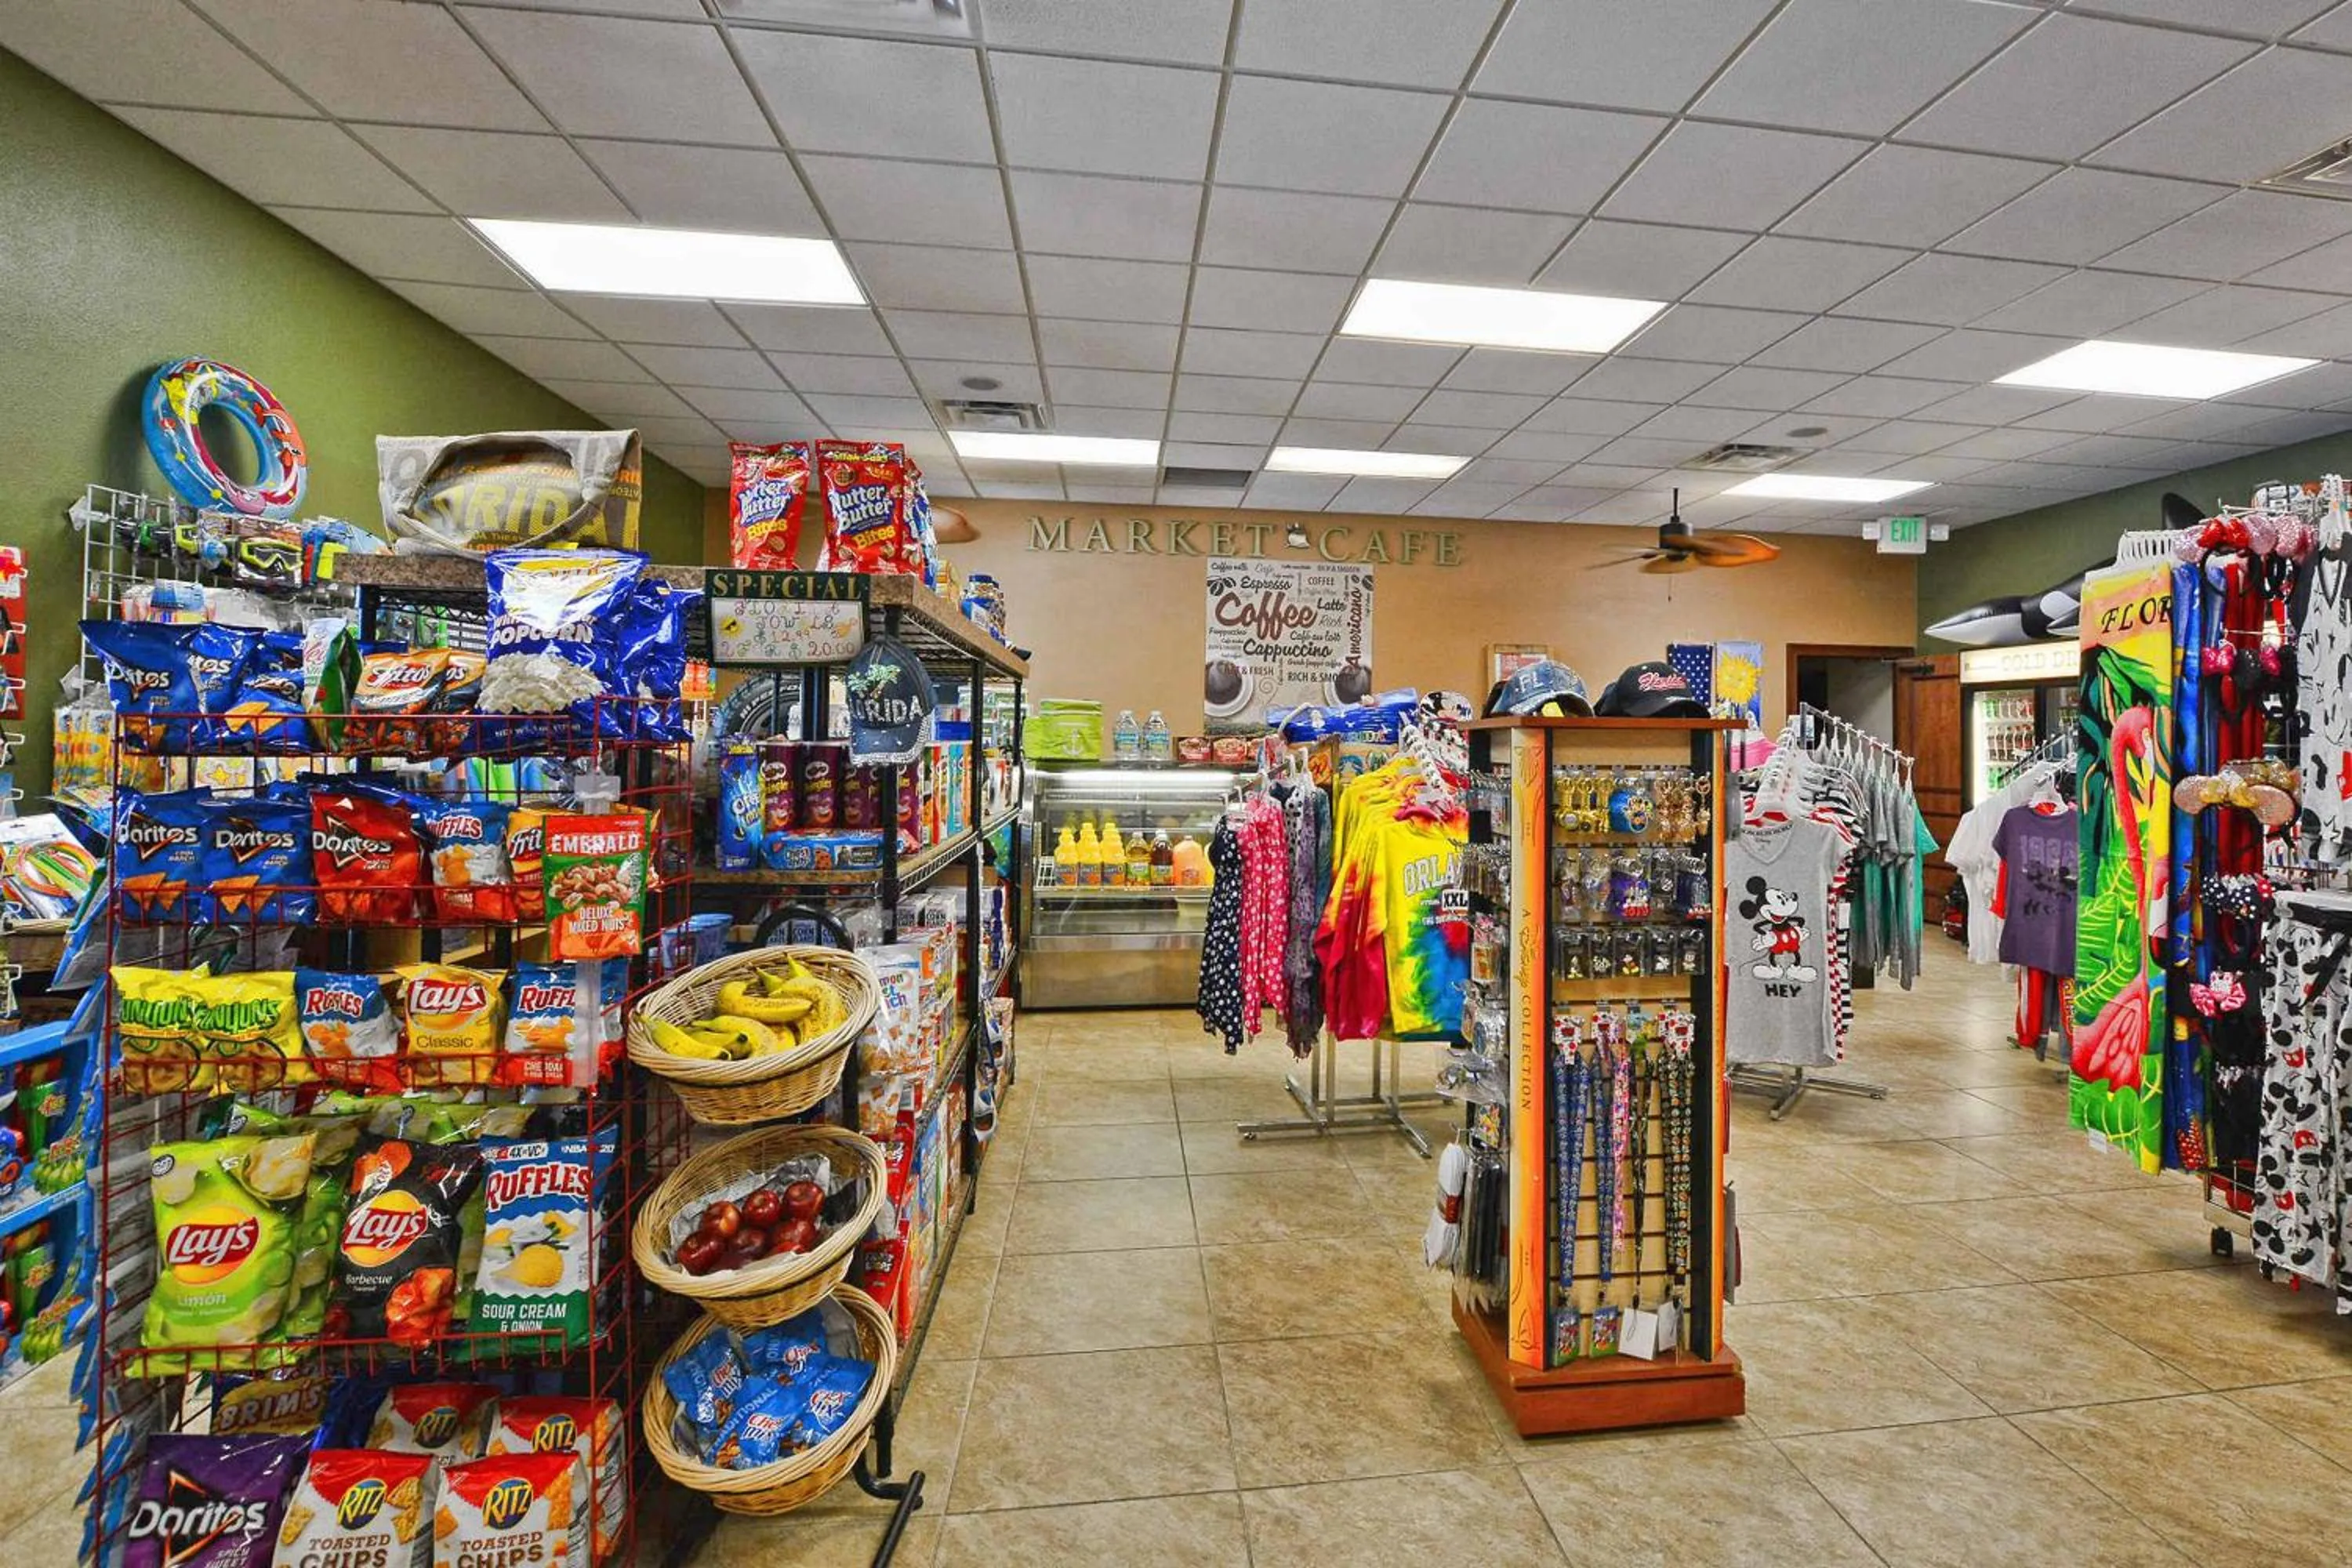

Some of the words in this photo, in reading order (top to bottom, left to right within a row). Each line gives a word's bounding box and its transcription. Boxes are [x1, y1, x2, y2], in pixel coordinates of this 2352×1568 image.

[829, 485, 886, 514] Nutter
[839, 499, 894, 531] Butter
[745, 518, 788, 539] Bites
[853, 524, 896, 549] Bites
[1890, 519, 1919, 544] EXIT
[1026, 517, 1276, 558] MARKET
[1319, 526, 1463, 566] CAFE
[1240, 575, 1293, 593] Espresso
[1307, 576, 1335, 586] COFFEE
[1215, 590, 1319, 641] Coffee
[1317, 597, 1347, 612] Latte
[2102, 594, 2172, 634] FLOR
[489, 622, 594, 650] POPCORN
[1243, 638, 1333, 662] Cappuccino
[1287, 672, 1308, 683] RICH
[1310, 673, 1318, 683] &
[855, 695, 924, 724] ORIDA
[118, 825, 198, 846] Doritos
[215, 829, 295, 849] Doritos
[312, 830, 392, 853] Doritos
[510, 828, 543, 858] Frit
[551, 831, 640, 854] EMERALD
[1403, 851, 1458, 898] ORLA
[1443, 891, 1468, 908] XXL
[581, 906, 613, 919] DELUXE
[570, 919, 599, 933] MIXED
[601, 918, 626, 932] NUTS
[518, 986, 576, 1013] RUFFL
[1764, 983, 1802, 999] HEY
[416, 1034, 474, 1050] Classic
[1521, 995, 1532, 1109] COLLECTION
[485, 1163, 594, 1212] RUFFLES
[344, 1207, 426, 1248] Lay's
[169, 1218, 257, 1266] Lay's
[346, 1273, 393, 1285] Barbecue
[482, 1303, 515, 1319] SOUR
[519, 1302, 568, 1319] CREAM
[500, 1320, 508, 1332] &
[511, 1320, 543, 1332] ONION
[414, 1412, 458, 1443] RITZ
[532, 1422, 577, 1451] RITZ
[336, 1486, 387, 1525] RITZ
[482, 1483, 533, 1526] RITZ
[128, 1500, 267, 1538] Doritos
[309, 1534, 390, 1551] TOASTED
[460, 1531, 543, 1552] TOASTED
[299, 1548, 389, 1568] CHIPS
[457, 1543, 545, 1568] CHIPS
